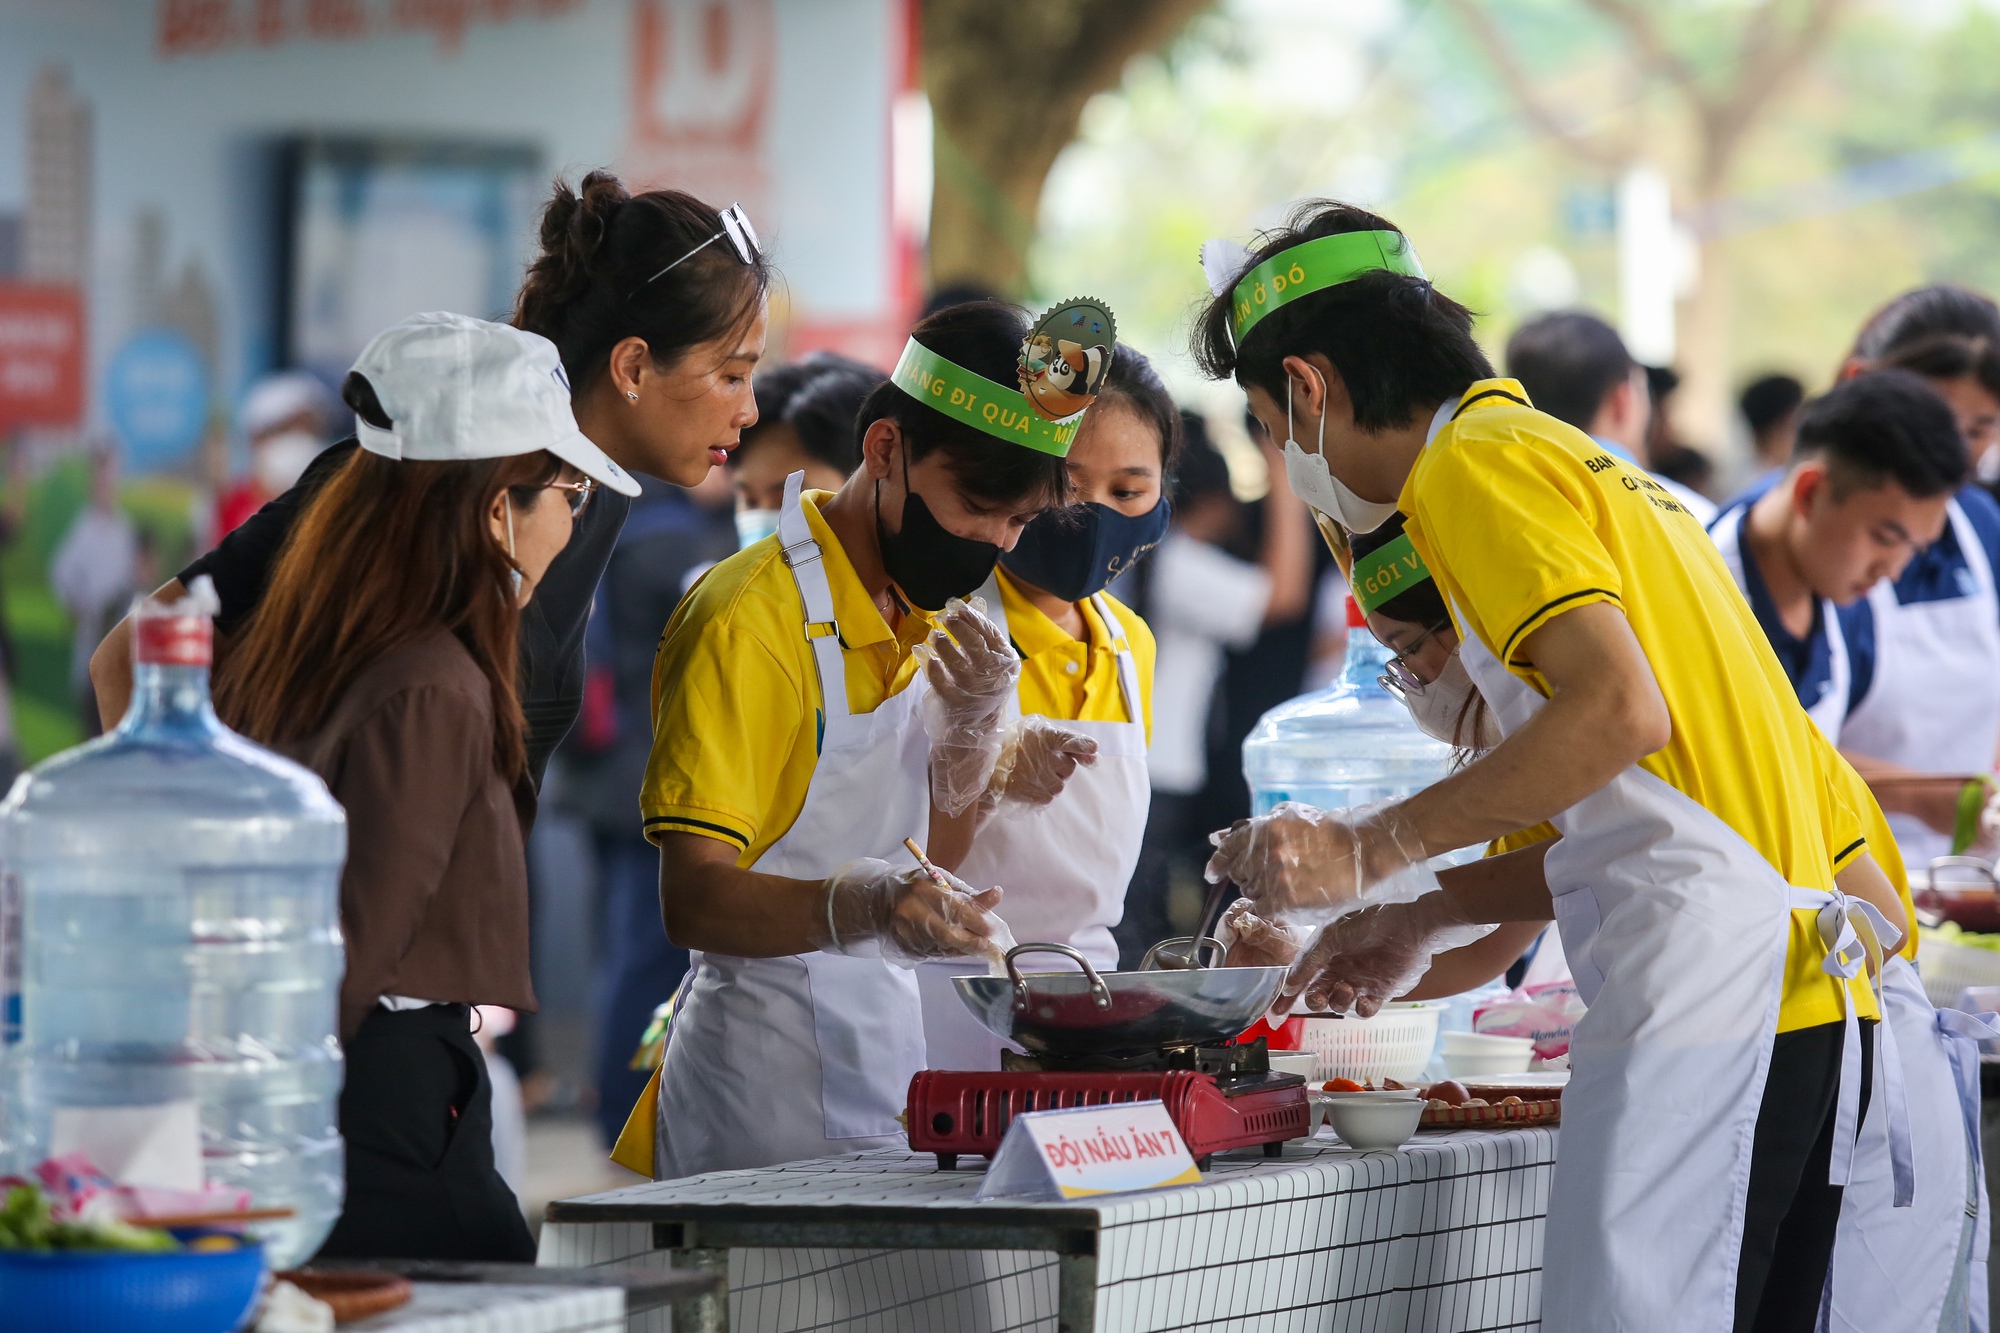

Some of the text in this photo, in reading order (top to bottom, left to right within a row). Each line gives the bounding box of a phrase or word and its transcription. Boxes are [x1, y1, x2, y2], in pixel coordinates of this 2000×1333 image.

[1254, 282, 1267, 305] Ở
[1272, 262, 1305, 293] ĐÓ
[950, 387, 977, 411] ĐI
[982, 402, 1029, 434] QUA
[1053, 424, 1074, 445] MÌ
[1584, 455, 1616, 473] BAN
[1365, 562, 1402, 594] GÓI
[1045, 1125, 1177, 1174] ĐỘI NẤU ĂN 7
